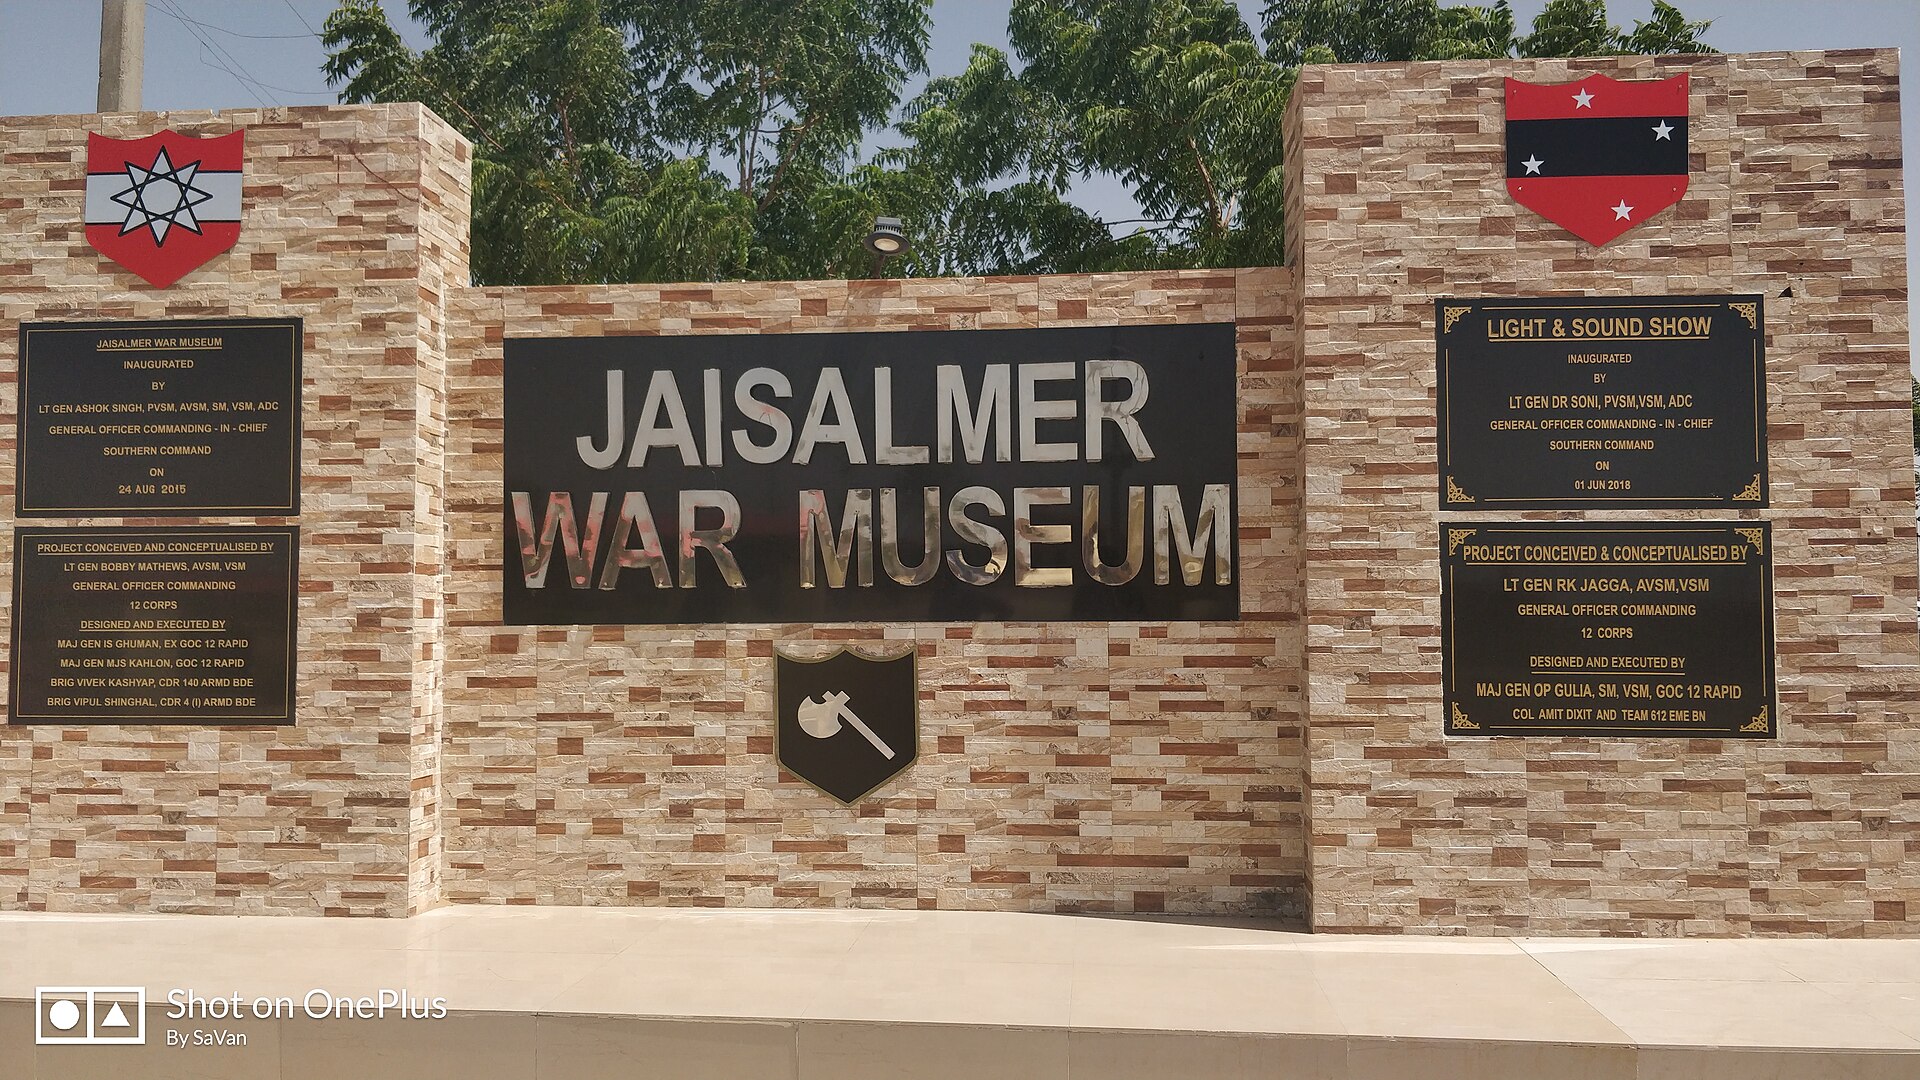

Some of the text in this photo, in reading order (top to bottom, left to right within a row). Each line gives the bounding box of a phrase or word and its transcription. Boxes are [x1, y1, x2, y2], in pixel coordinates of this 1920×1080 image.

[1487, 316, 1712, 338] LIGHT & SOUND SHOW
[97, 337, 222, 348] JAISALMER WAR MUSEUM
[124, 359, 194, 369] INAUGURATED
[1568, 353, 1632, 364] INAUGURATED
[1594, 374, 1606, 383] BY
[152, 382, 165, 390] BY
[39, 401, 279, 415] LT GEN ASHOK SINGH, PVSM, AVSM, SM, VSM, ADC
[1509, 396, 1522, 409] LT
[1524, 396, 1549, 409] GEN
[1552, 396, 1568, 409] DR
[1571, 395, 1601, 410] SONI,
[1669, 395, 1693, 408] ADC
[576, 358, 1155, 469] JAISALMER
[49, 425, 97, 435] GENERAL
[99, 425, 141, 435] OFFICER
[143, 424, 212, 434] COMMANDING
[220, 424, 230, 433] IN
[238, 423, 268, 433] CHIEF
[1490, 420, 1538, 430] GENERAL
[1540, 419, 1584, 429] OFFICER
[1586, 419, 1656, 429] COMMANDING
[1665, 419, 1675, 429] IN
[1684, 418, 1713, 429] CHIEF
[103, 445, 211, 456] SOUTHERN COMMAND
[1549, 440, 1654, 450] SOUTHERN COMMAND
[1595, 461, 1609, 471] ON
[149, 468, 164, 477] ON
[118, 484, 186, 494] 24 AUG 2015
[1574, 480, 1631, 490] 01 JUN 2018
[511, 483, 1232, 589] WAR MUSEUM
[37, 542, 274, 553] PROJECT CONCEIVED AND CONCEPTUALISED BY
[1463, 545, 1748, 561] PROJECT CONCEIVED & CONCEPTUALISED BY
[64, 562, 246, 573] LT GEN BOBBY MATHEWS, AVSM, VSM
[72, 581, 236, 591] GENERAL OFFICER COMMANDING
[1504, 579, 1519, 592] LT
[1523, 579, 1553, 592] GEN
[1556, 579, 1577, 592] RK
[1580, 579, 1633, 593] JAGGA,
[130, 601, 178, 610] 12 CORPS
[1517, 604, 1696, 616] GENERAL OFFICER COMMANDING
[80, 620, 226, 629] DESIGNED AND EXECUTED BY
[1581, 627, 1633, 639] 12 CORPS
[57, 639, 249, 650] MAJ GEN IS GHUMAN, EX GOC 12 RAPID
[60, 658, 244, 669] MAJ GEN MJS KAHLON, GOC 12 RAPID
[1530, 657, 1685, 669] DESIGNED AND EXECUTED BY
[50, 678, 254, 689] BRIG VIVEK KASHYAP, CDR 140 ARMD BDE
[1476, 683, 1742, 700] MAJ GEN OP GULIA, SM, VSM, GOC 12 RAPID
[47, 697, 256, 708] BRIG VIPUL SHINGHAL, CDR 4 (I) ARMD BDE
[1512, 708, 1706, 722] COL AMIT DIXIT AND TEAM 612 EME BN
